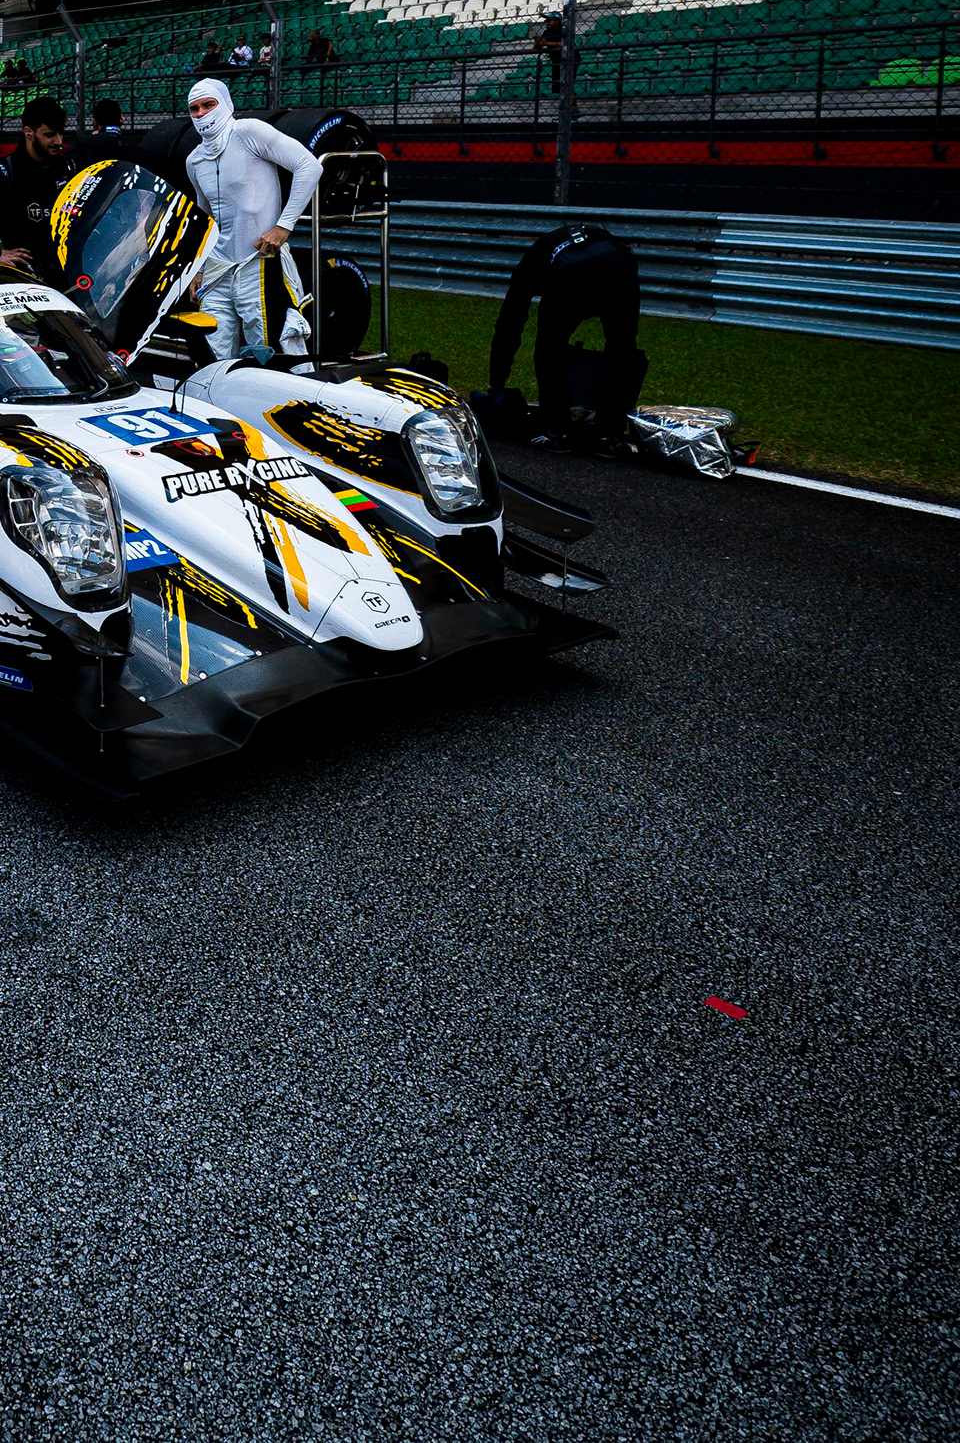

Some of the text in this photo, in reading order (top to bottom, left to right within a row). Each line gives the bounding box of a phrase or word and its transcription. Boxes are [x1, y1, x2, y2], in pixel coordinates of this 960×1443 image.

[310, 117, 342, 150] MICHELIN
[29, 208, 41, 217] TF
[342, 259, 368, 288] MICHELIN
[14, 294, 50, 304] MANS
[107, 410, 198, 438] 91
[166, 468, 225, 500] PURE
[126, 539, 167, 561] MP2
[366, 596, 382, 608] TF
